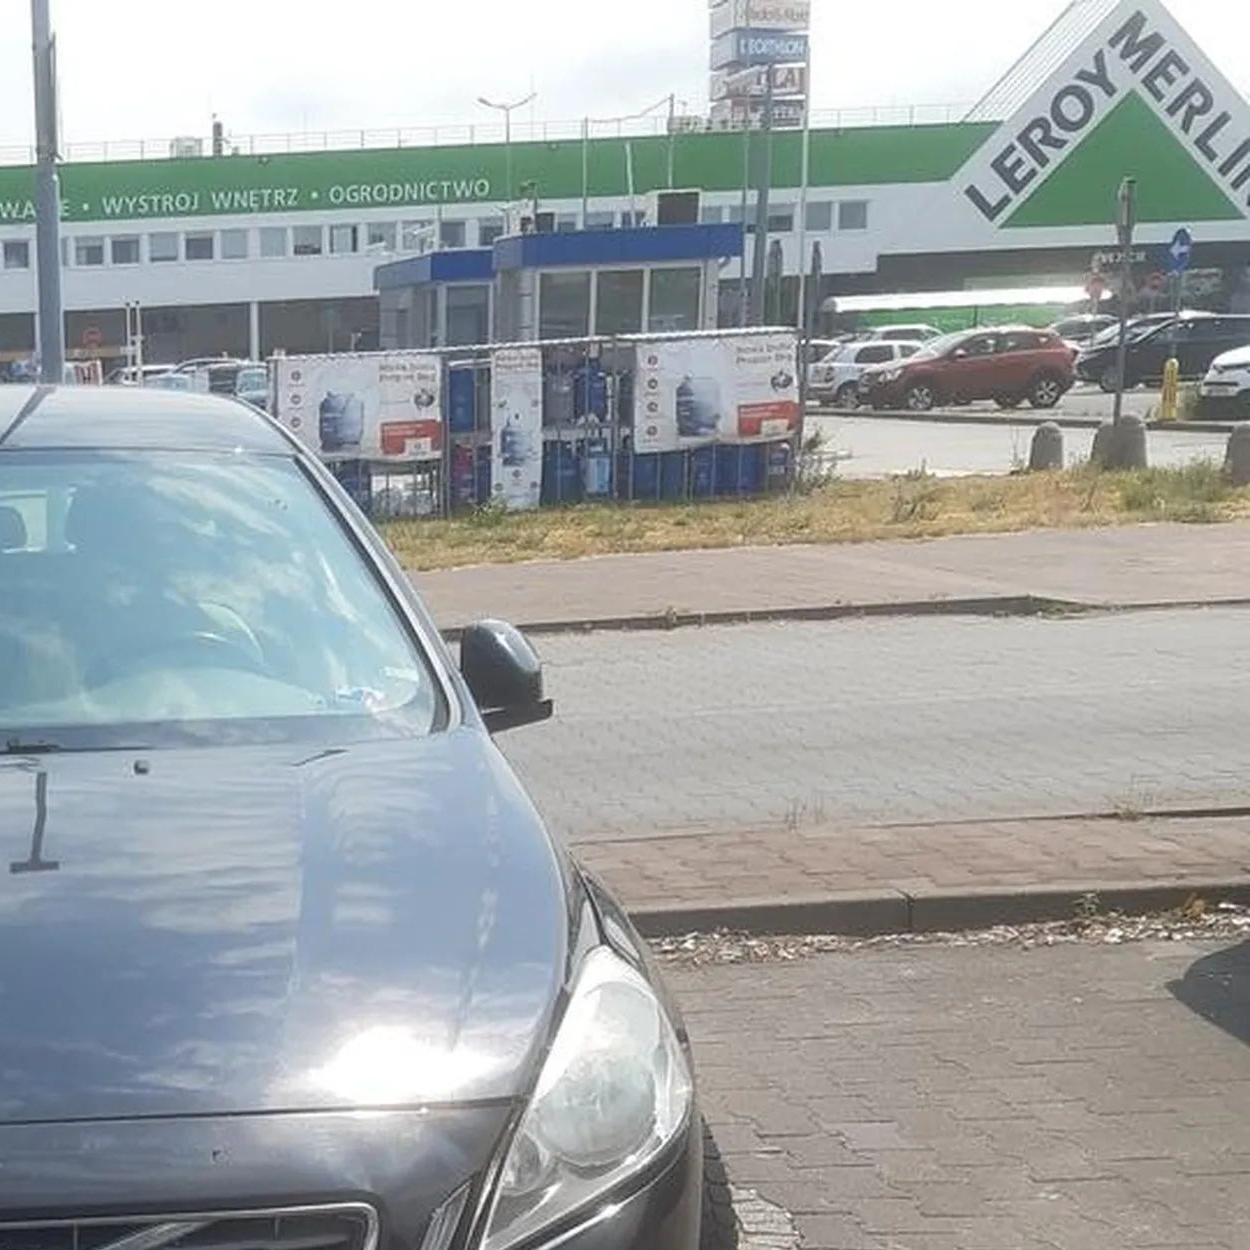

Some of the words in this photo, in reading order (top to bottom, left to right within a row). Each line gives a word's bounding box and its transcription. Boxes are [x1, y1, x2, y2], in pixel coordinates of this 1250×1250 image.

[964, 49, 1117, 222] LEROY
[1108, 10, 1250, 206] MERLI
[329, 180, 490, 204] OGRODNICTWO
